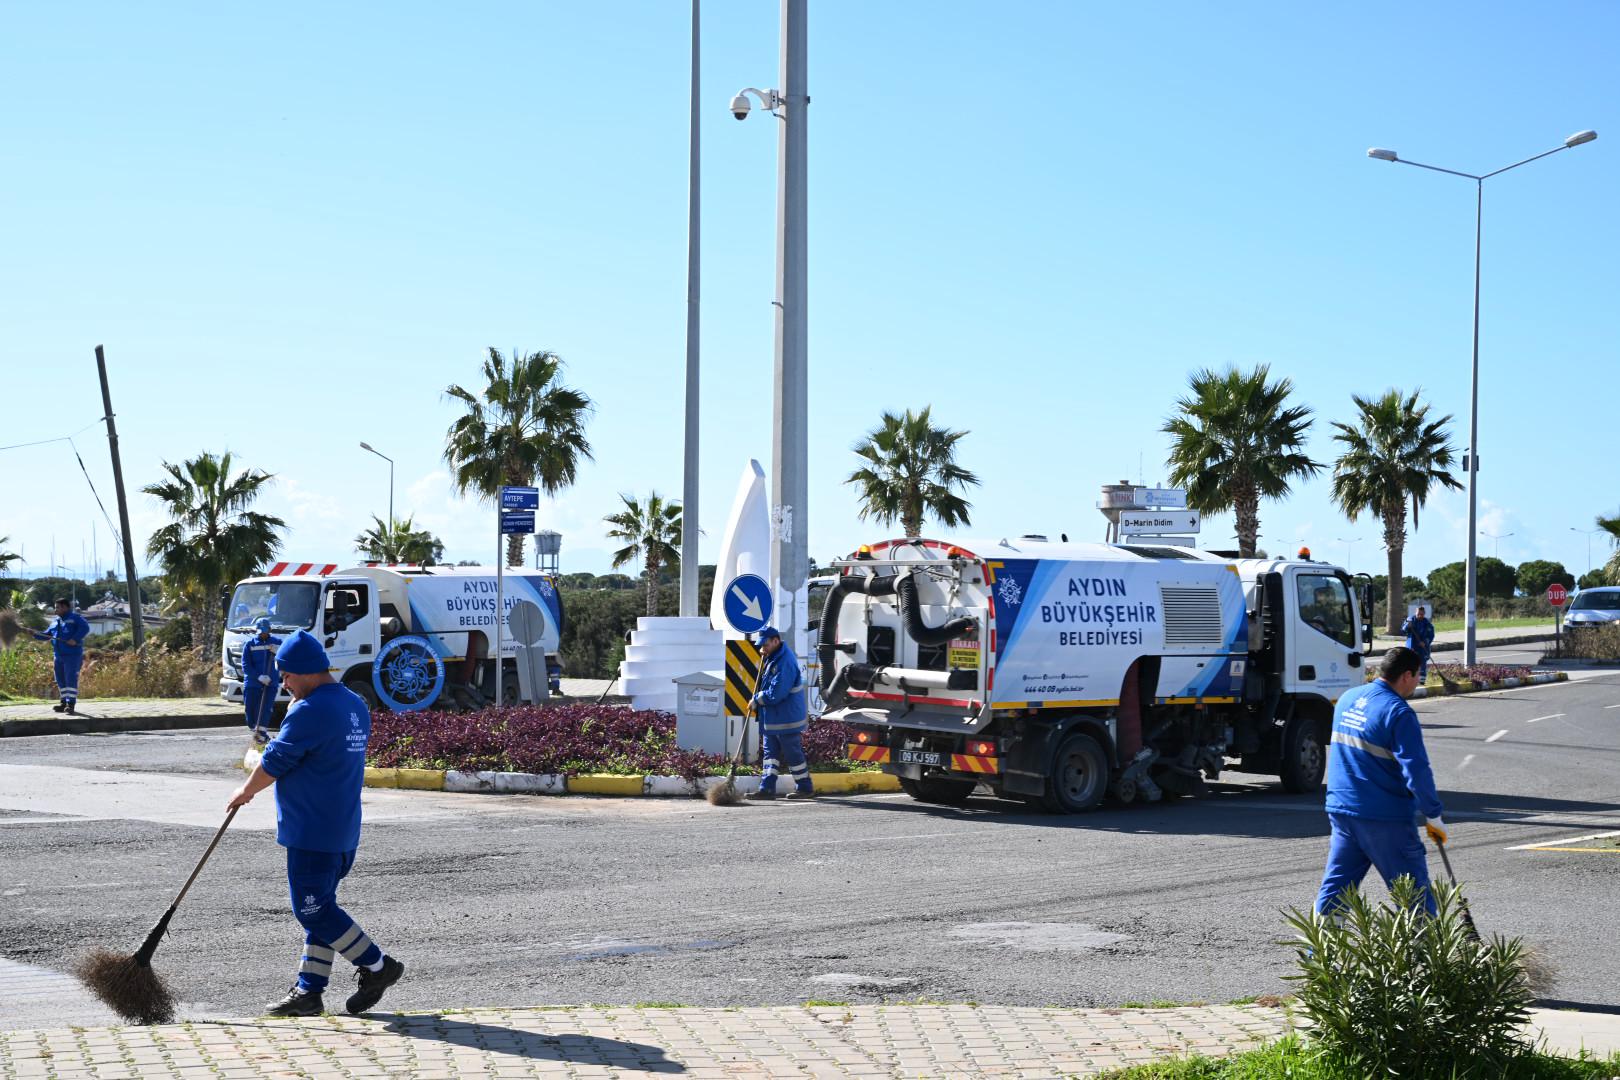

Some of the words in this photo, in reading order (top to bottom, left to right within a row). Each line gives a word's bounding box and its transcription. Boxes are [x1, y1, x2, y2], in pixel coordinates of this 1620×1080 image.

[1068, 578, 1126, 596] AYDIN
[1548, 590, 1565, 600] DUR
[1041, 601, 1157, 628] BÜYÜKŞEHİR
[1060, 628, 1142, 646] BELEDİYESİ
[902, 752, 911, 762] 09
[925, 753, 939, 764] 597
